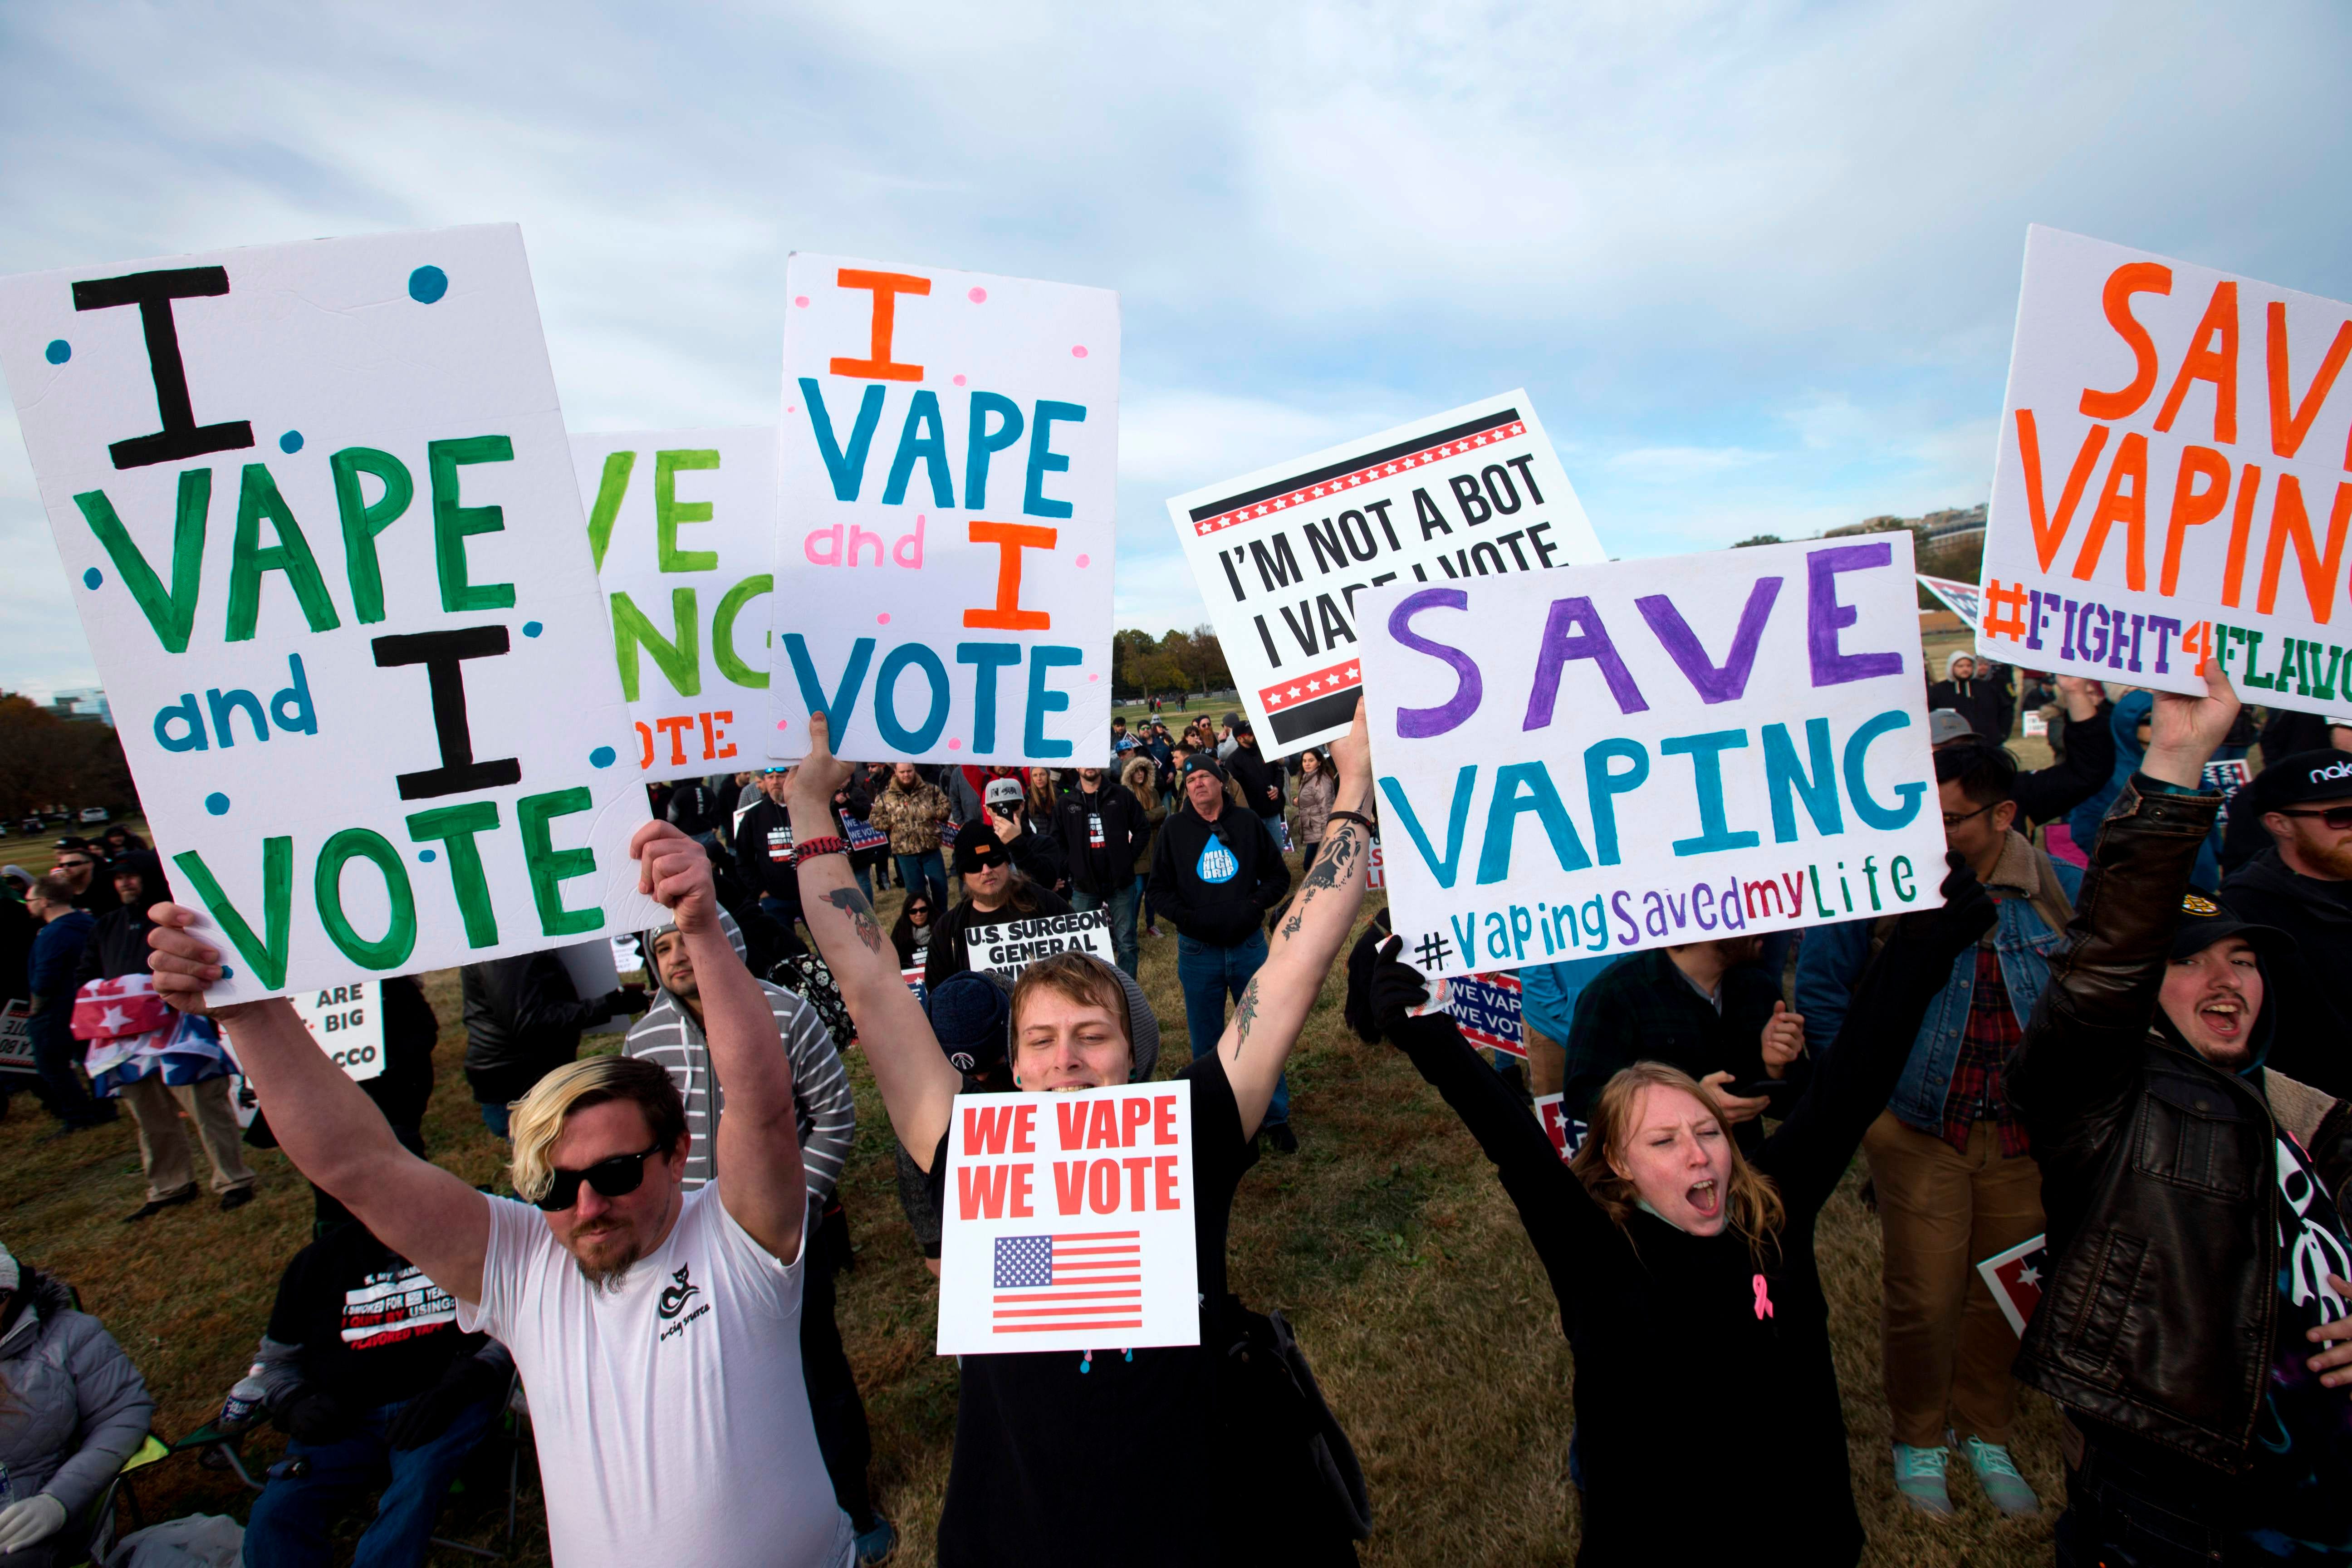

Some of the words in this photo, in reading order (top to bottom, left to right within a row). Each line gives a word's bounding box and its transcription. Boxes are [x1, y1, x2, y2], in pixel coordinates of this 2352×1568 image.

[72, 266, 254, 470] I
[830, 269, 931, 381] I
[2080, 263, 2352, 472] SAV
[799, 377, 1086, 519] VAPE
[73, 435, 515, 653] VAPE
[804, 514, 925, 569] and
[964, 521, 1057, 630] I
[1219, 532, 1303, 602] I'M
[1303, 499, 1402, 574] NOT
[1412, 487, 1453, 541] A
[1448, 453, 1545, 527] BOT
[2015, 409, 2352, 624] VAPIN
[782, 633, 1083, 759] VOTE
[1254, 614, 1282, 668] I
[1388, 543, 1903, 738] SAVE
[154, 653, 317, 752] and
[372, 625, 521, 800] I
[1378, 710, 1927, 889] VAPING
[2309, 761, 2352, 784] nak
[172, 786, 604, 991] VOTE
[849, 830, 862, 839] WE
[966, 926, 1003, 946] U.S.
[1008, 910, 1107, 941] SURGEON
[989, 934, 1098, 964] GENERAL
[316, 983, 363, 1008] ARE
[325, 1009, 363, 1032] BIG
[965, 1105, 1036, 1155] WE
[1057, 1096, 1177, 1150] VAPE
[959, 1164, 1033, 1219] WE
[1054, 1156, 1179, 1214] VOTE
[386, 1294, 403, 1311] FOR
[386, 1309, 405, 1323] BY
[409, 1298, 455, 1317] USING:
